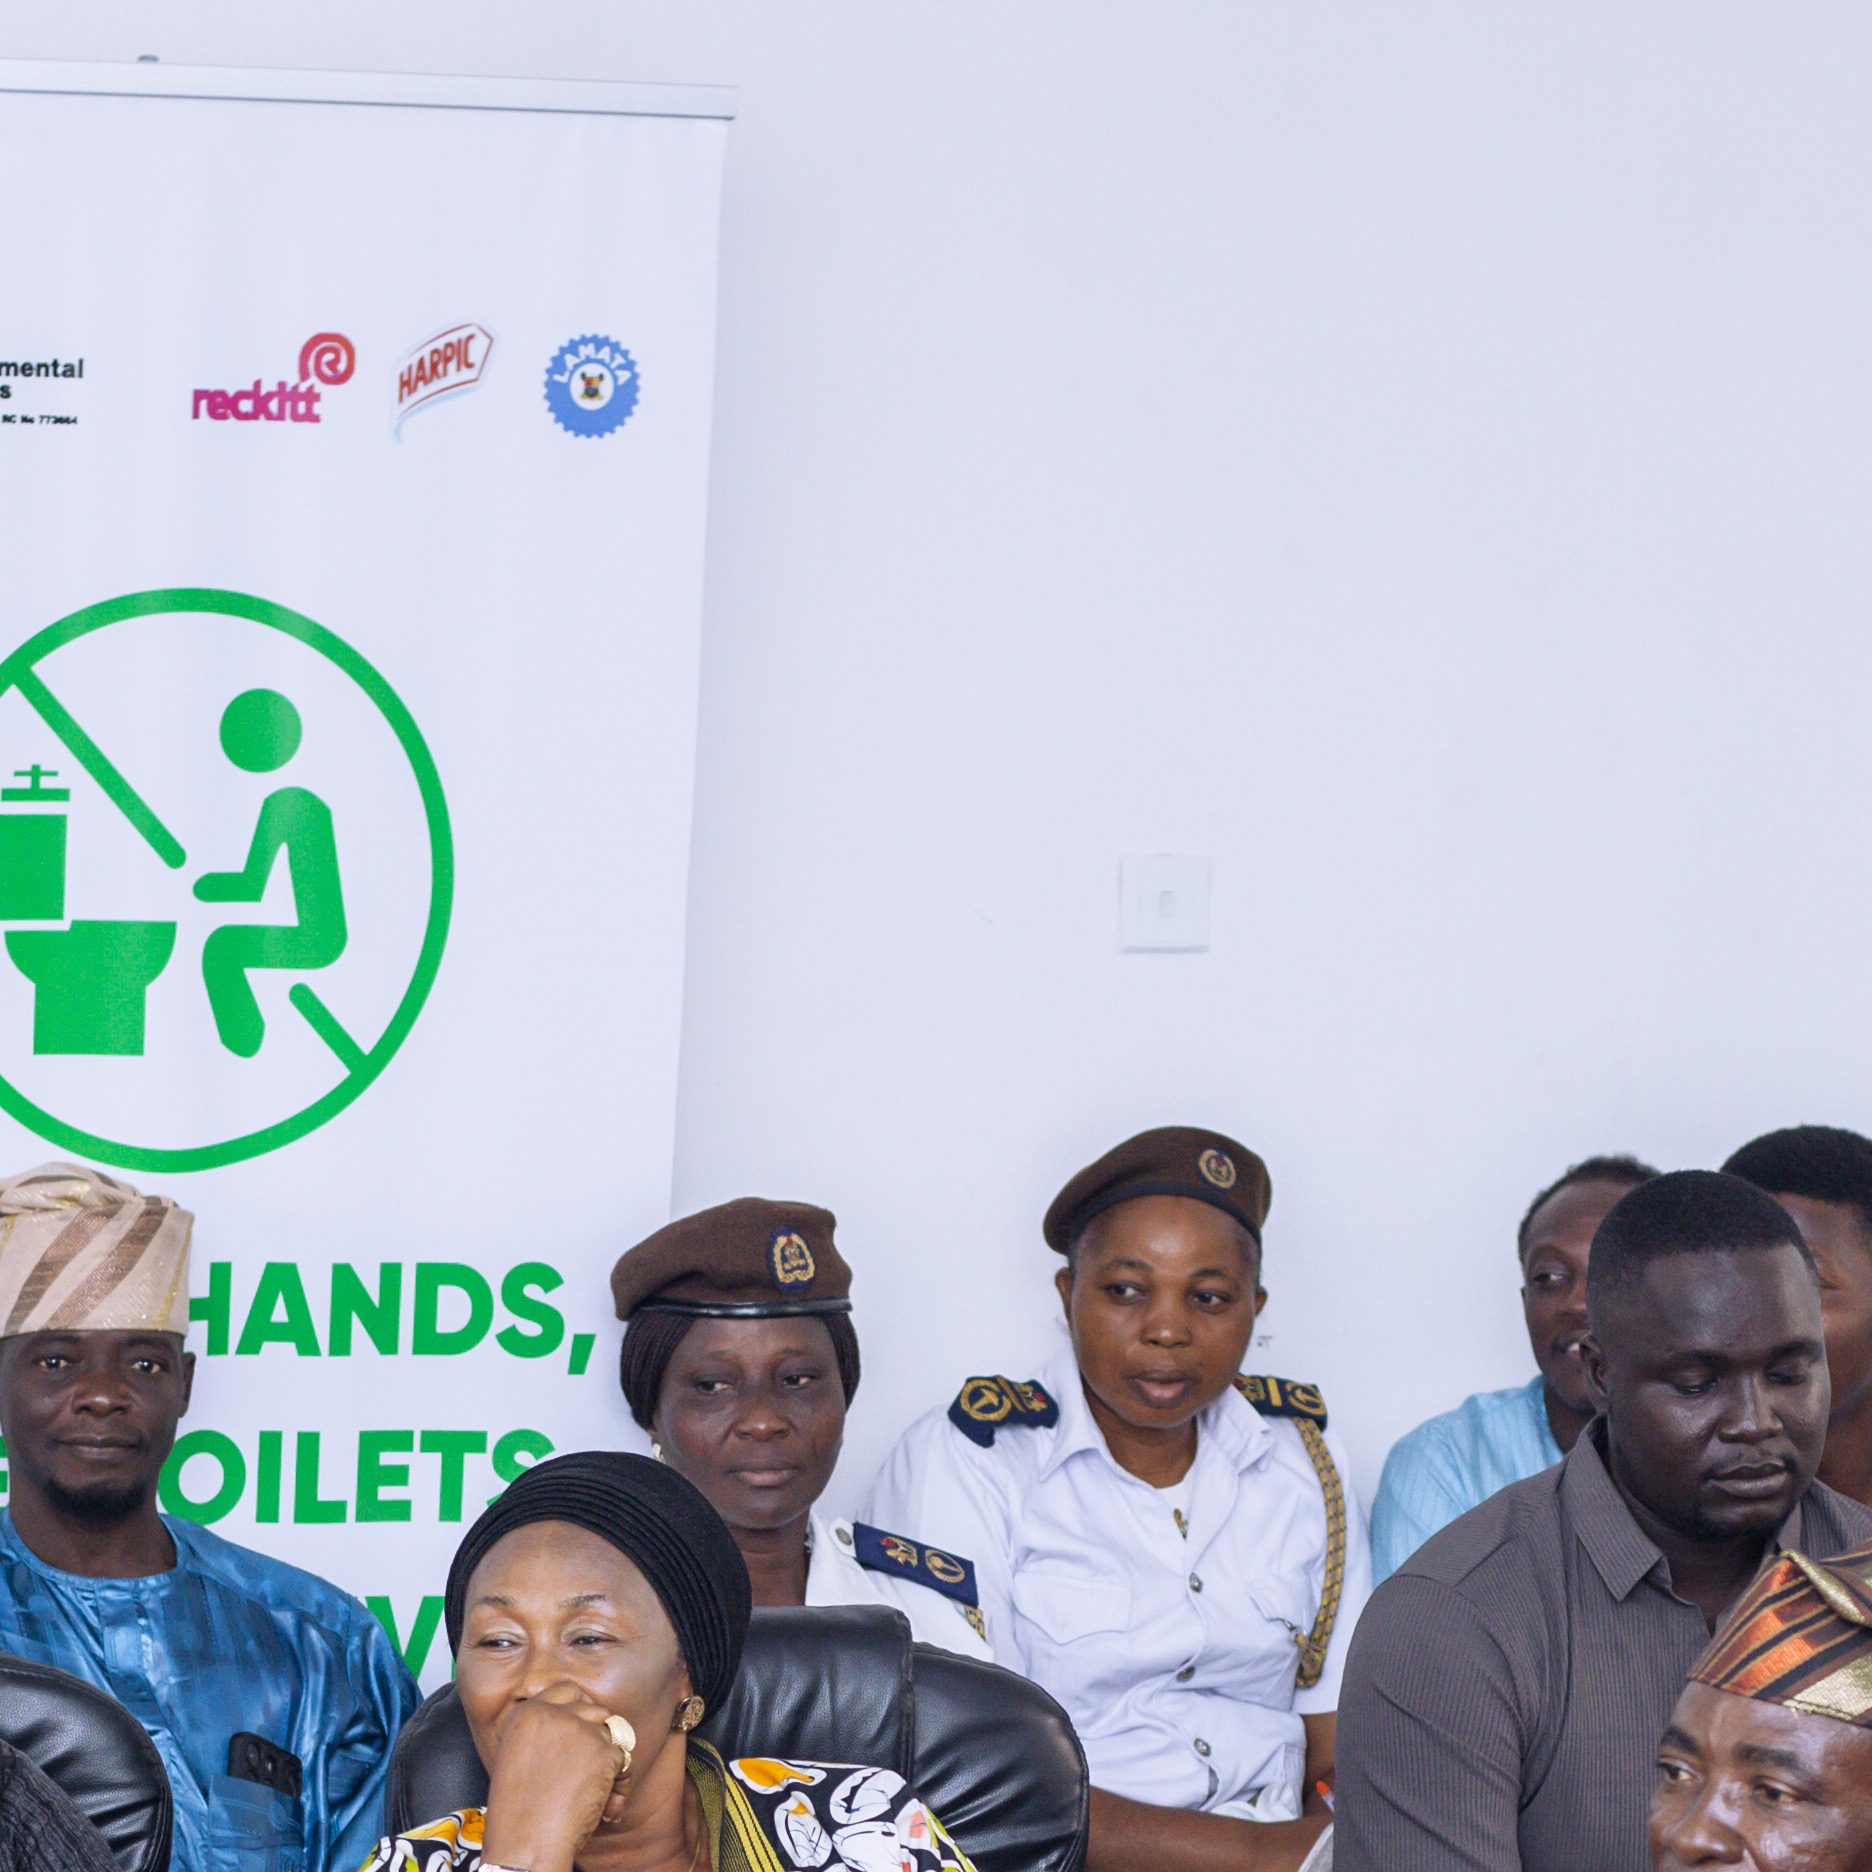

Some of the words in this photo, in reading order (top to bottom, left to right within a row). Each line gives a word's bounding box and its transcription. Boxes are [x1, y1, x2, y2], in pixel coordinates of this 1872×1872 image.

[398, 334, 477, 404] HARPIC
[552, 342, 632, 386] LAMATA
[192, 380, 321, 423] reckitt
[158, 1429, 555, 1527] OILETS
